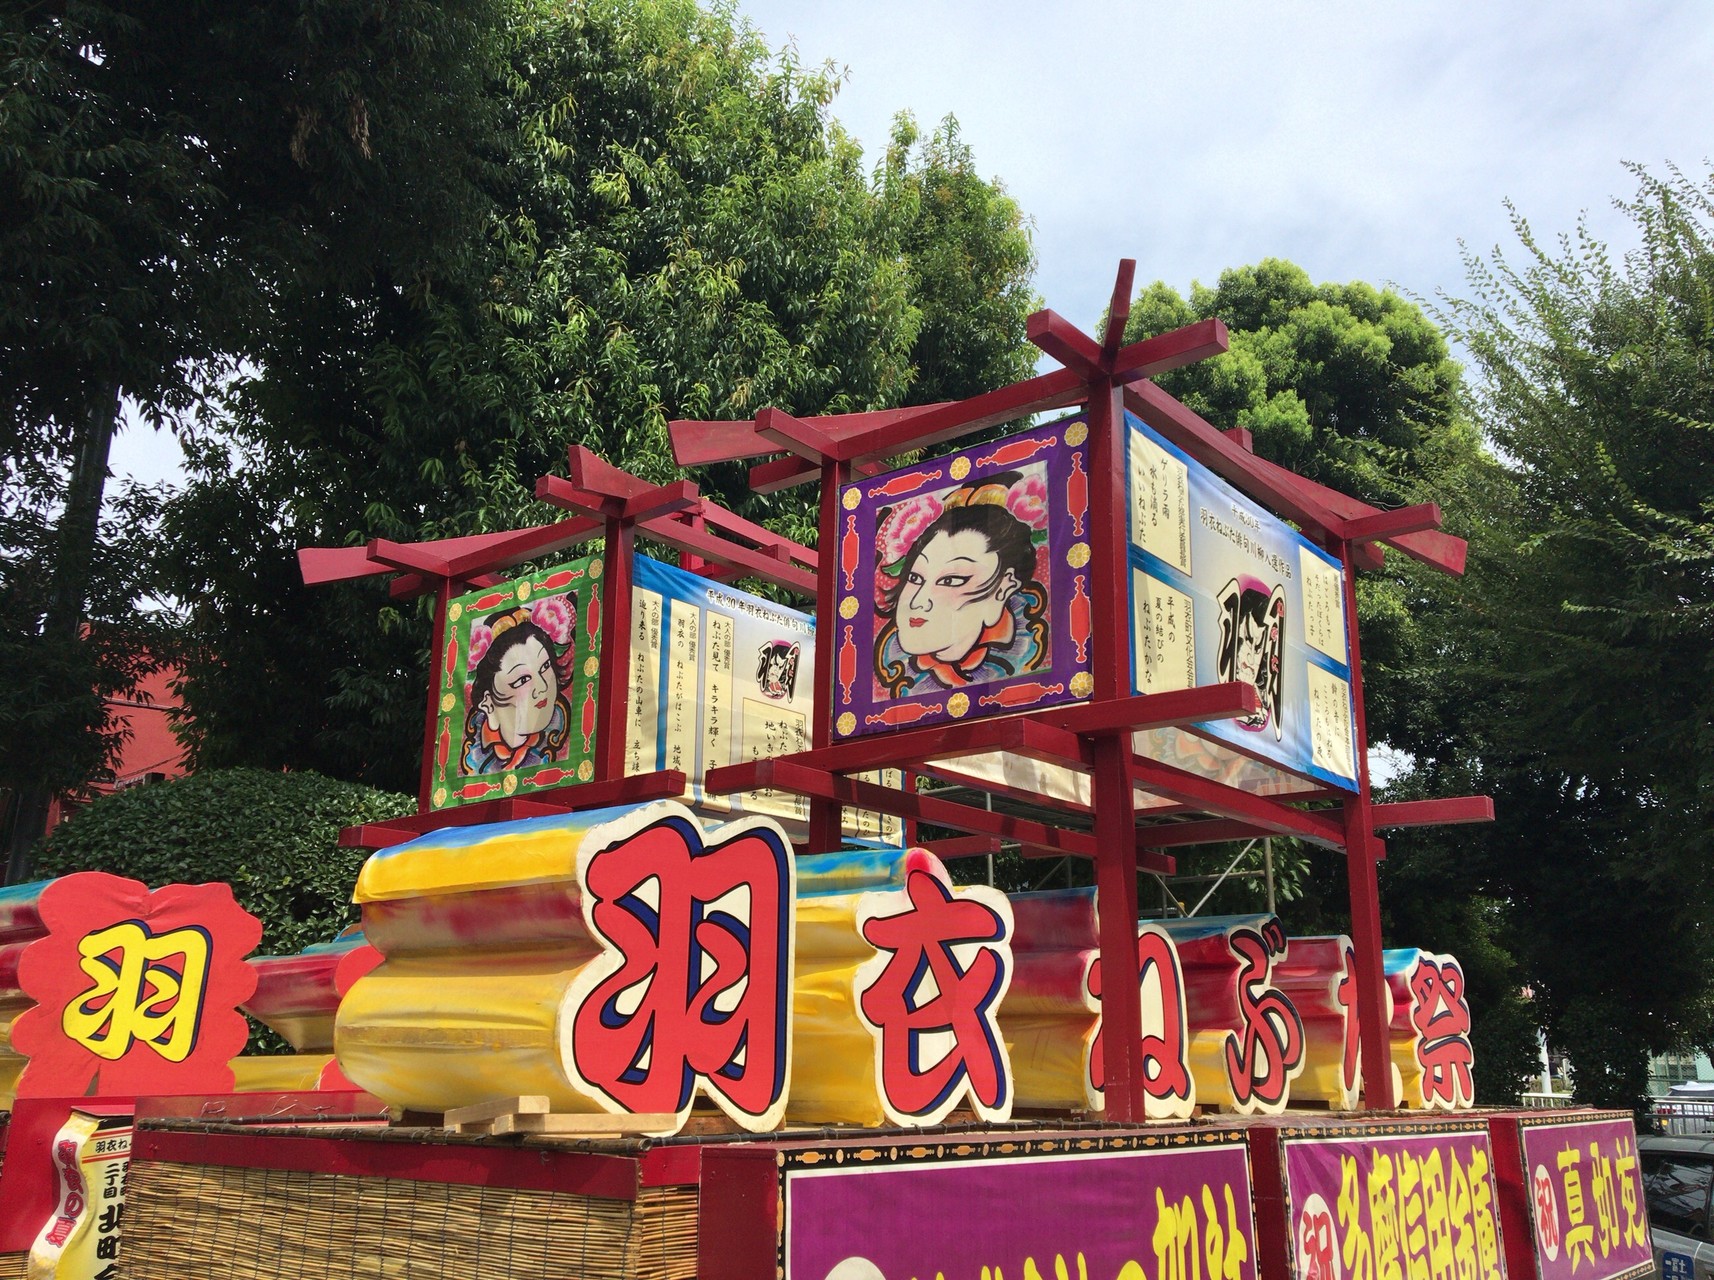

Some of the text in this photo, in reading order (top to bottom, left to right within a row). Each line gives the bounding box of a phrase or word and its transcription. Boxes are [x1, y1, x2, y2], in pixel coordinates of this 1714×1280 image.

[62, 919, 213, 1062] 羽
[95, 1139, 132, 1153] 羽衣ね
[1535, 1177, 1559, 1249] 祝
